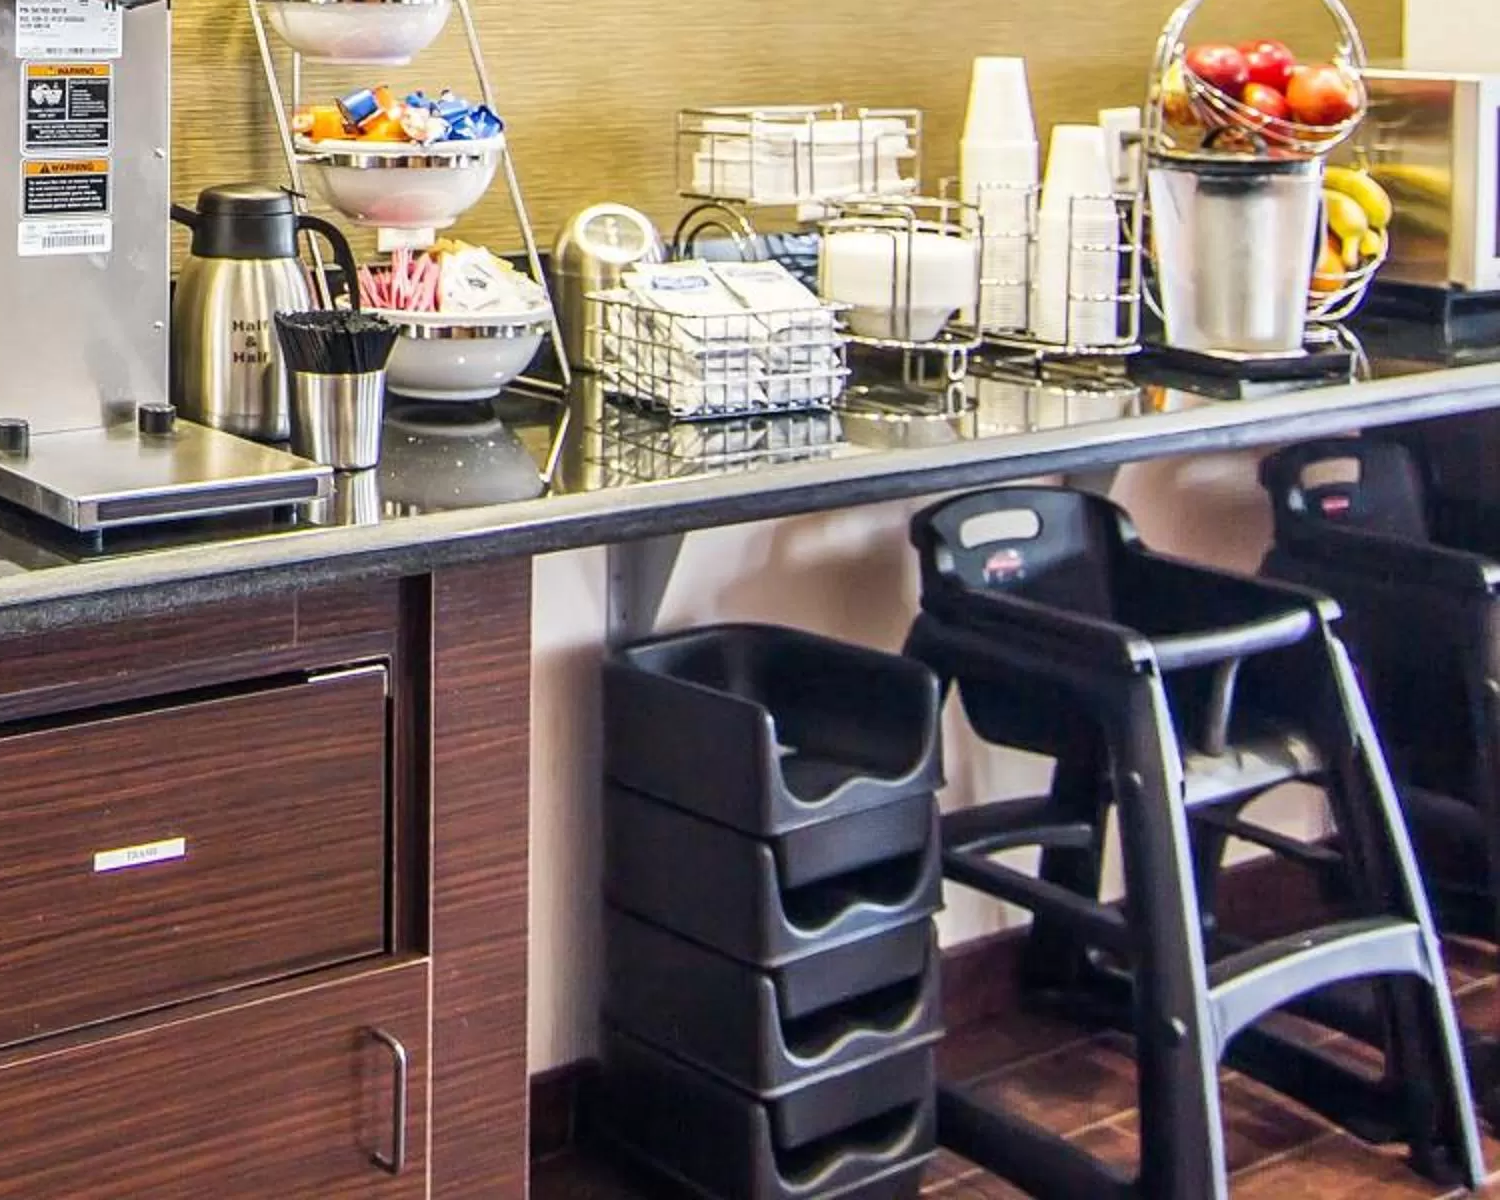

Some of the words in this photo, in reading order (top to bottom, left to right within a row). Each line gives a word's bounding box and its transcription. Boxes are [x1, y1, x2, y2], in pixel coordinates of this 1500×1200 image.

[57, 67, 95, 76] WARNING
[51, 162, 95, 173] WARNING
[244, 335, 257, 348] &
